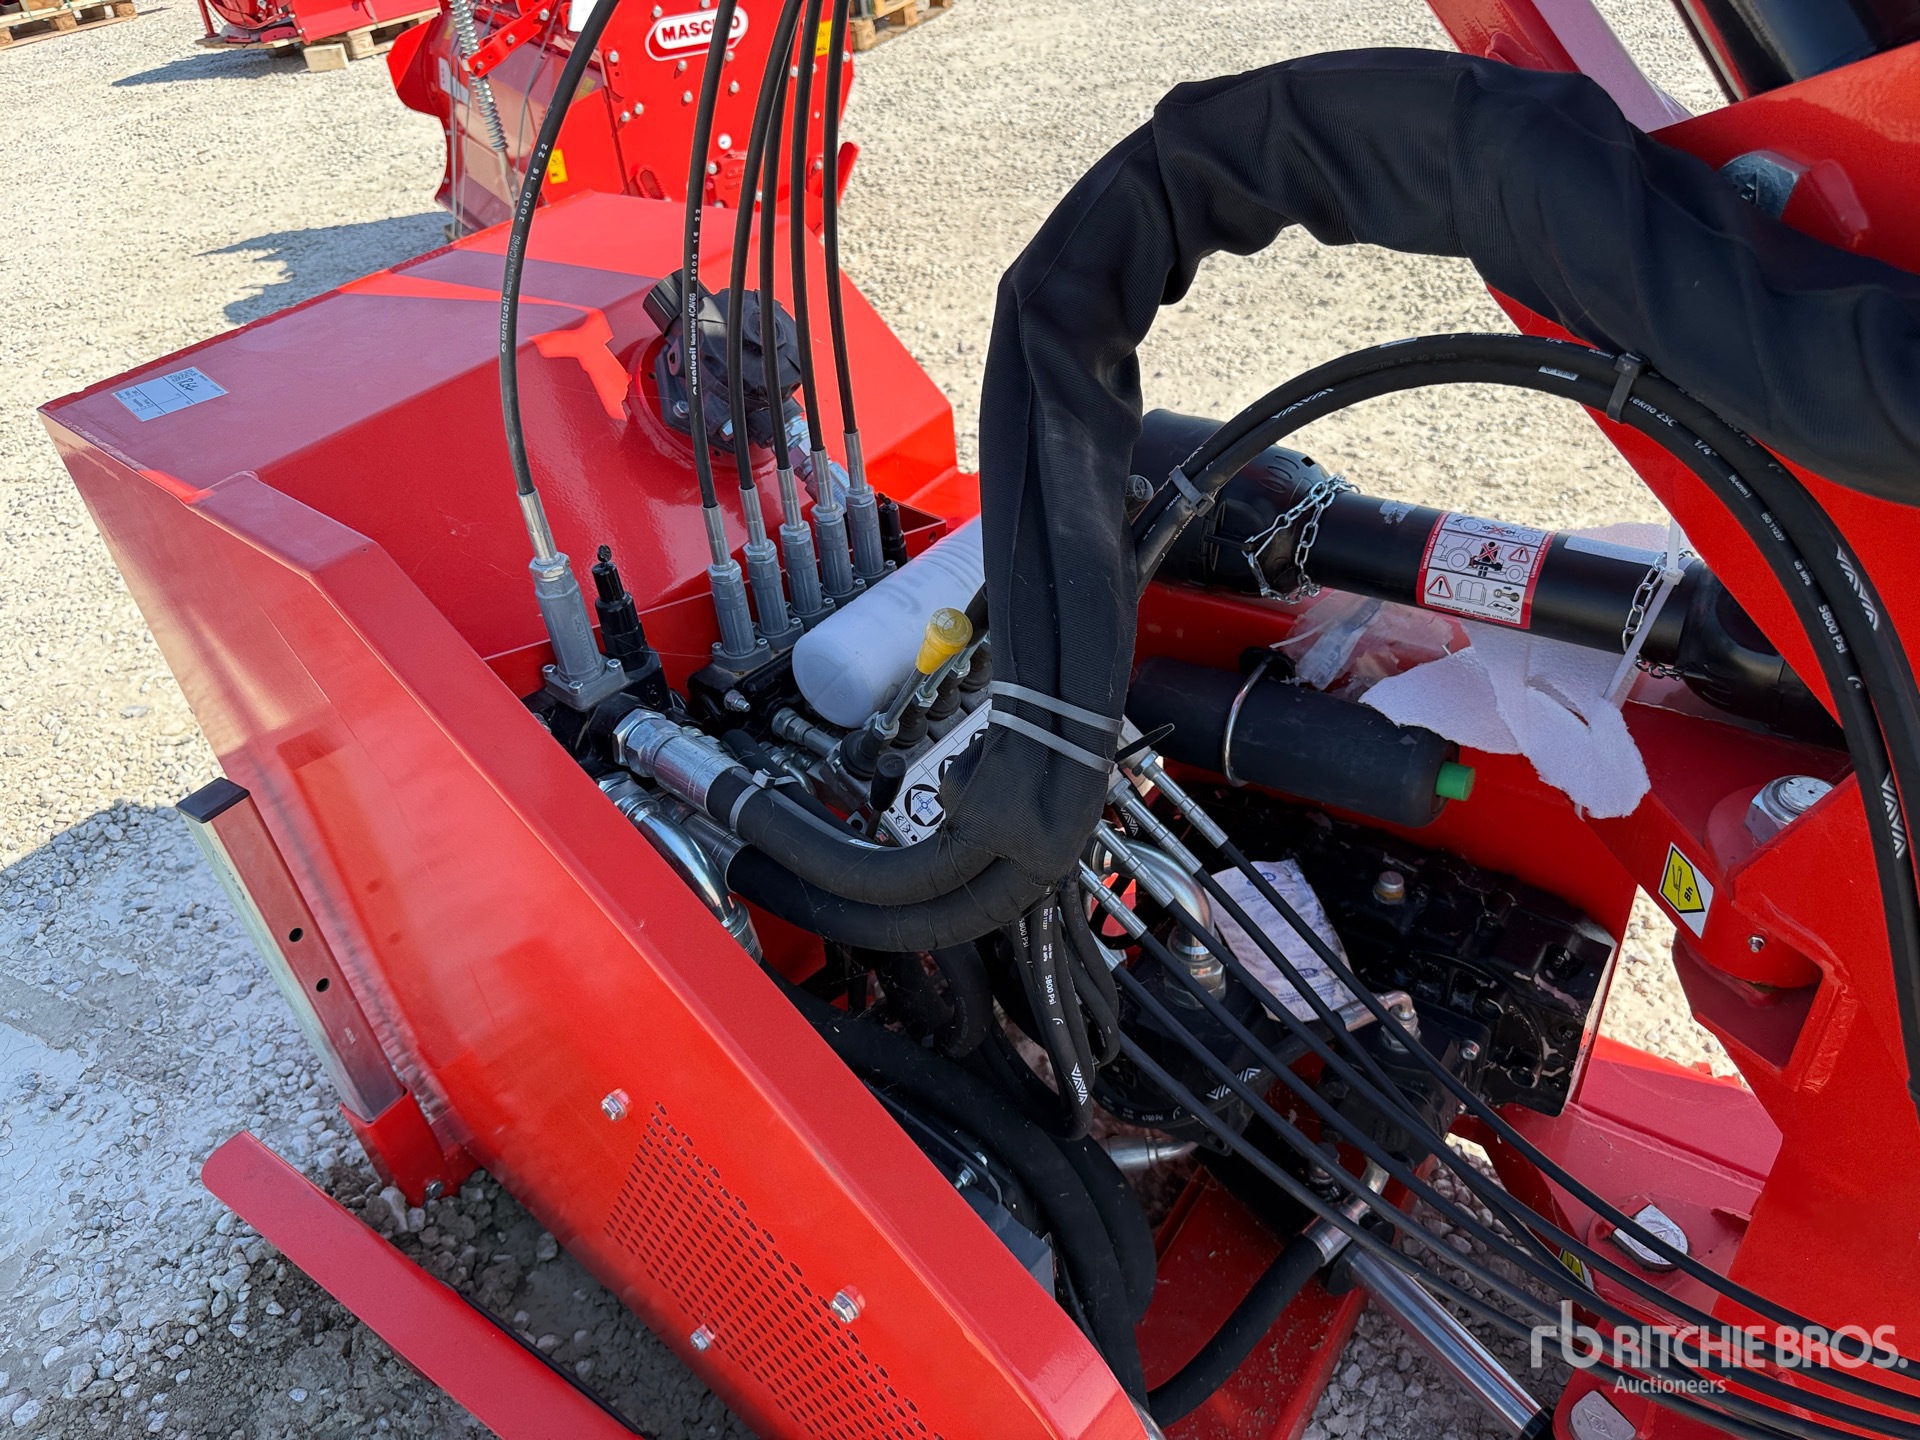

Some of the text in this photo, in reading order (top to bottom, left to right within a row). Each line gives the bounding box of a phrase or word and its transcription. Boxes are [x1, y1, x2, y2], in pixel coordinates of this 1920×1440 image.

[518, 192, 532, 223] 3000
[531, 168, 540, 182] 16
[538, 143, 549, 159] 22
[694, 208, 702, 222] 22
[693, 231, 699, 244] 16
[1656, 412, 1678, 427] 2SC
[1760, 512, 1772, 524] ISO
[1769, 523, 1786, 542] 11237
[1793, 560, 1803, 571] 40
[1799, 571, 1812, 587] MPa
[1818, 604, 1839, 635] 5800
[1832, 634, 1848, 654] Psi
[1683, 886, 1694, 902] 8h
[1019, 917, 1031, 948] 5800 Psi
[1045, 974, 1054, 994] 5800
[1047, 994, 1057, 1006] Psi
